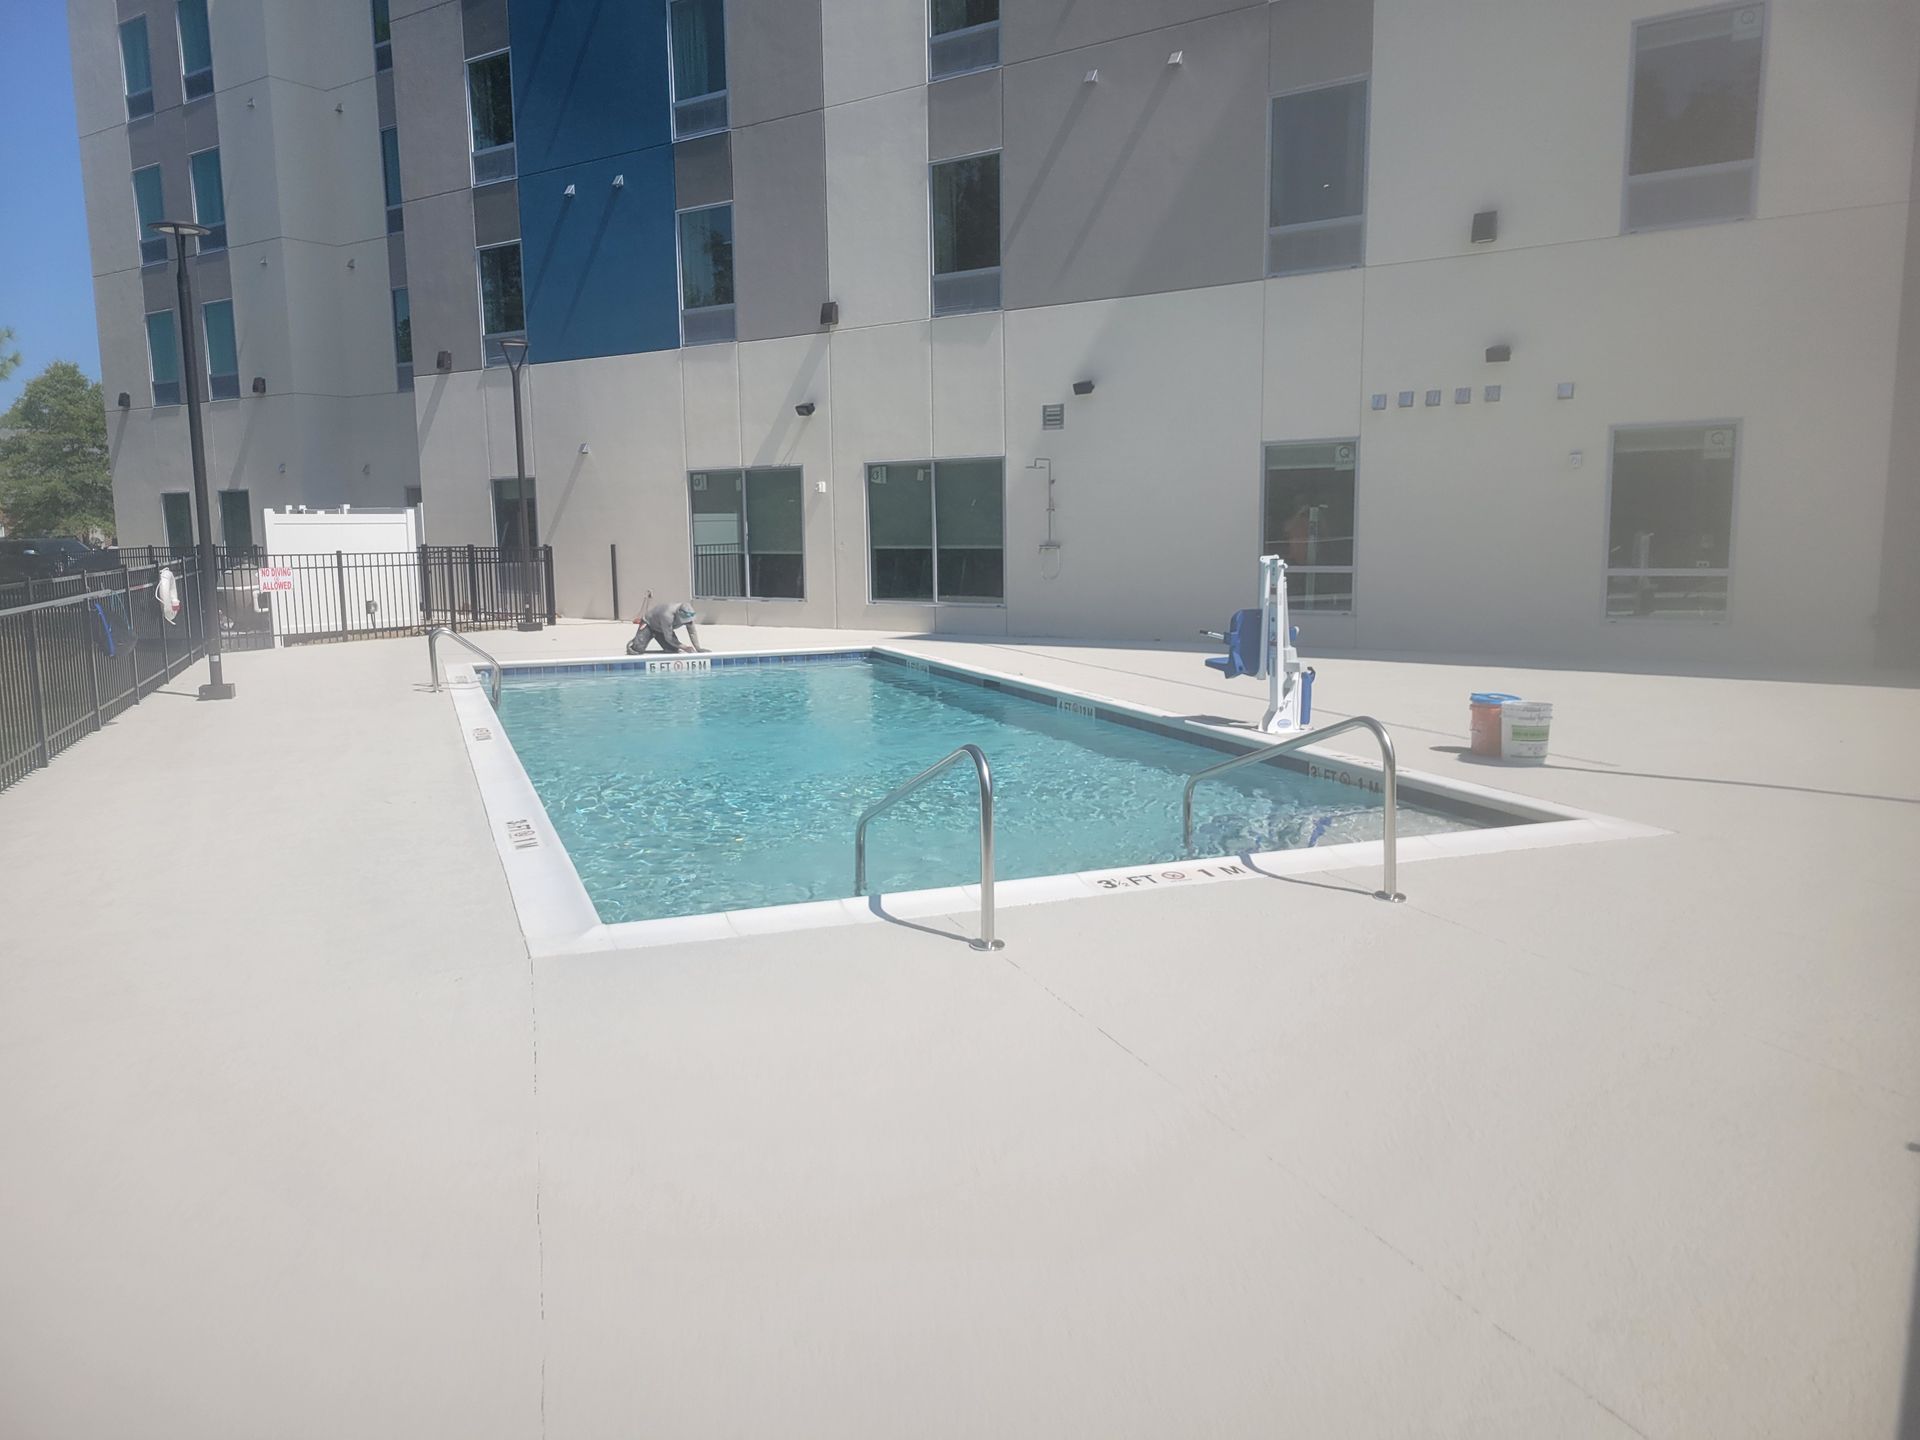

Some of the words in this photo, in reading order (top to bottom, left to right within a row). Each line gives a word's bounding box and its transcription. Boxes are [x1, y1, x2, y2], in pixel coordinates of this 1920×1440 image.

[261, 569, 270, 577] NO
[271, 568, 292, 577] DIVING
[262, 581, 292, 590] ALLOWED
[660, 662, 671, 672] FT
[699, 660, 707, 669] M
[1324, 769, 1337, 784] FT
[1358, 777, 1364, 789] 1
[1368, 780, 1380, 793] M
[1126, 873, 1159, 886] FT
[1197, 869, 1216, 878] 1
[1218, 865, 1247, 876] M
